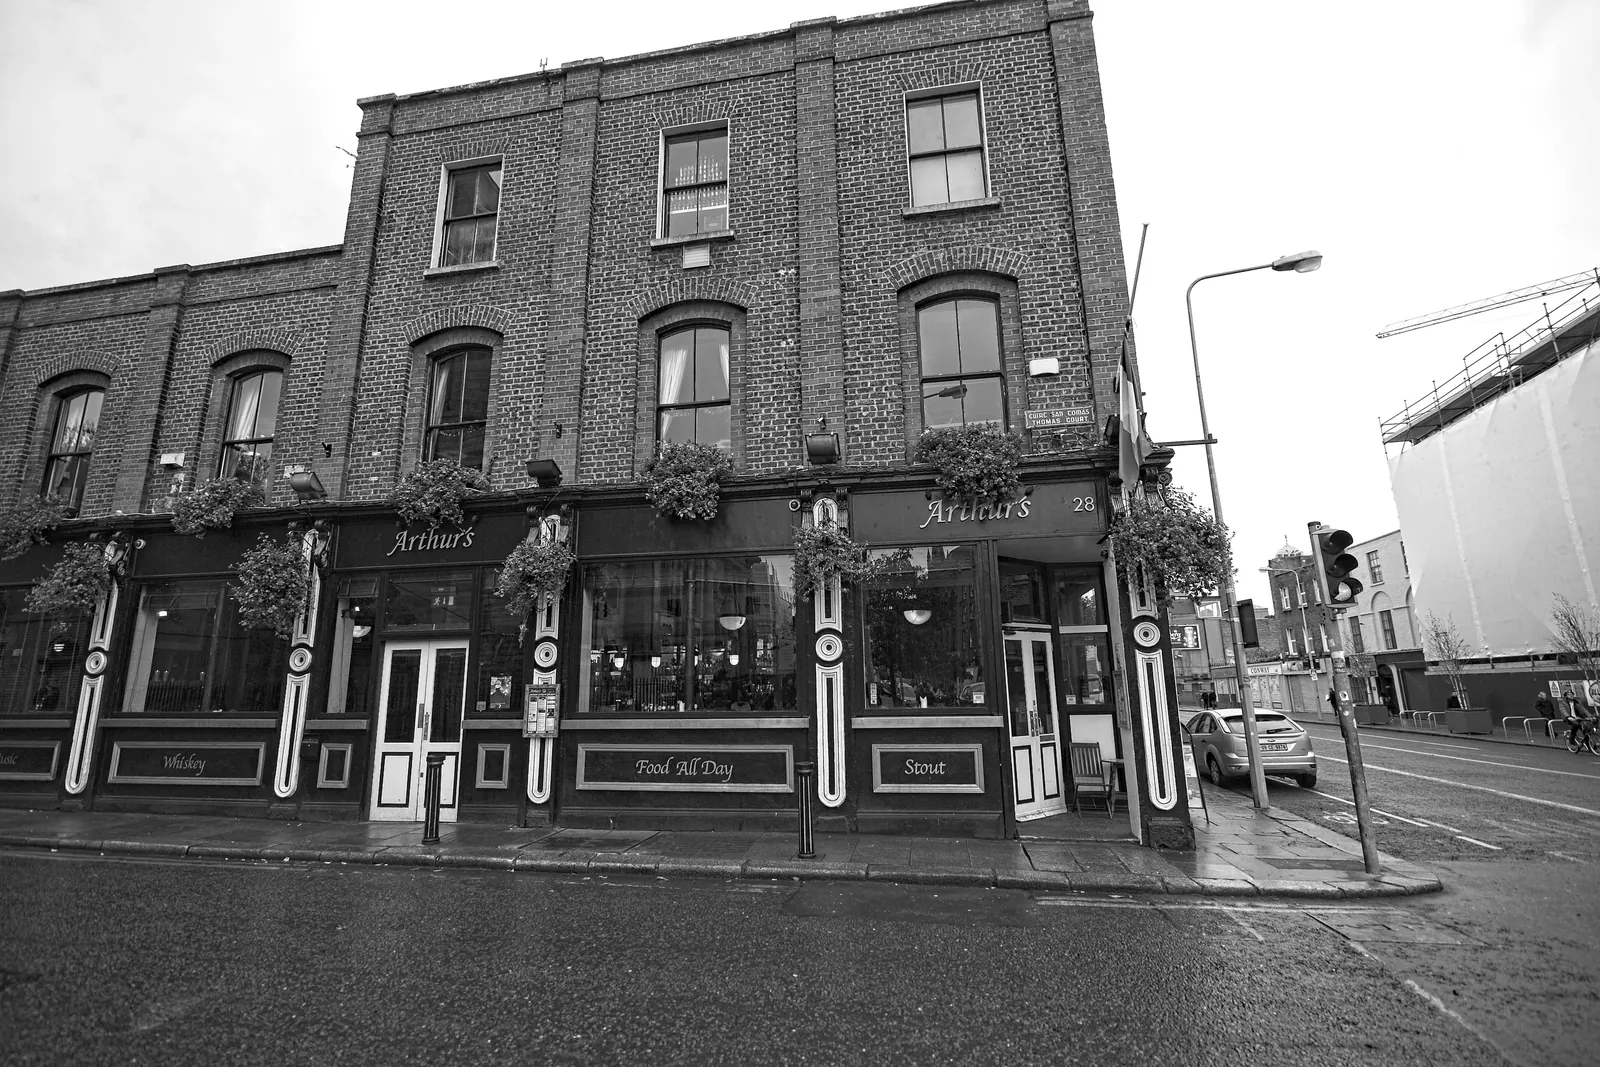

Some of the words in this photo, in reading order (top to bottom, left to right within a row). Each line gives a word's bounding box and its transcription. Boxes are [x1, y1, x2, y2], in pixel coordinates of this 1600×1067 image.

[919, 496, 1033, 529] Arthur's
[1072, 496, 1095, 512] 28
[386, 526, 476, 557] Arthur's
[1250, 666, 1270, 674] CONWAY
[0, 752, 18, 765] usic
[163, 752, 206, 776] Whiskey
[904, 758, 947, 775] Stout
[635, 756, 675, 775] Food
[676, 757, 702, 776] All
[701, 760, 735, 783] Day
